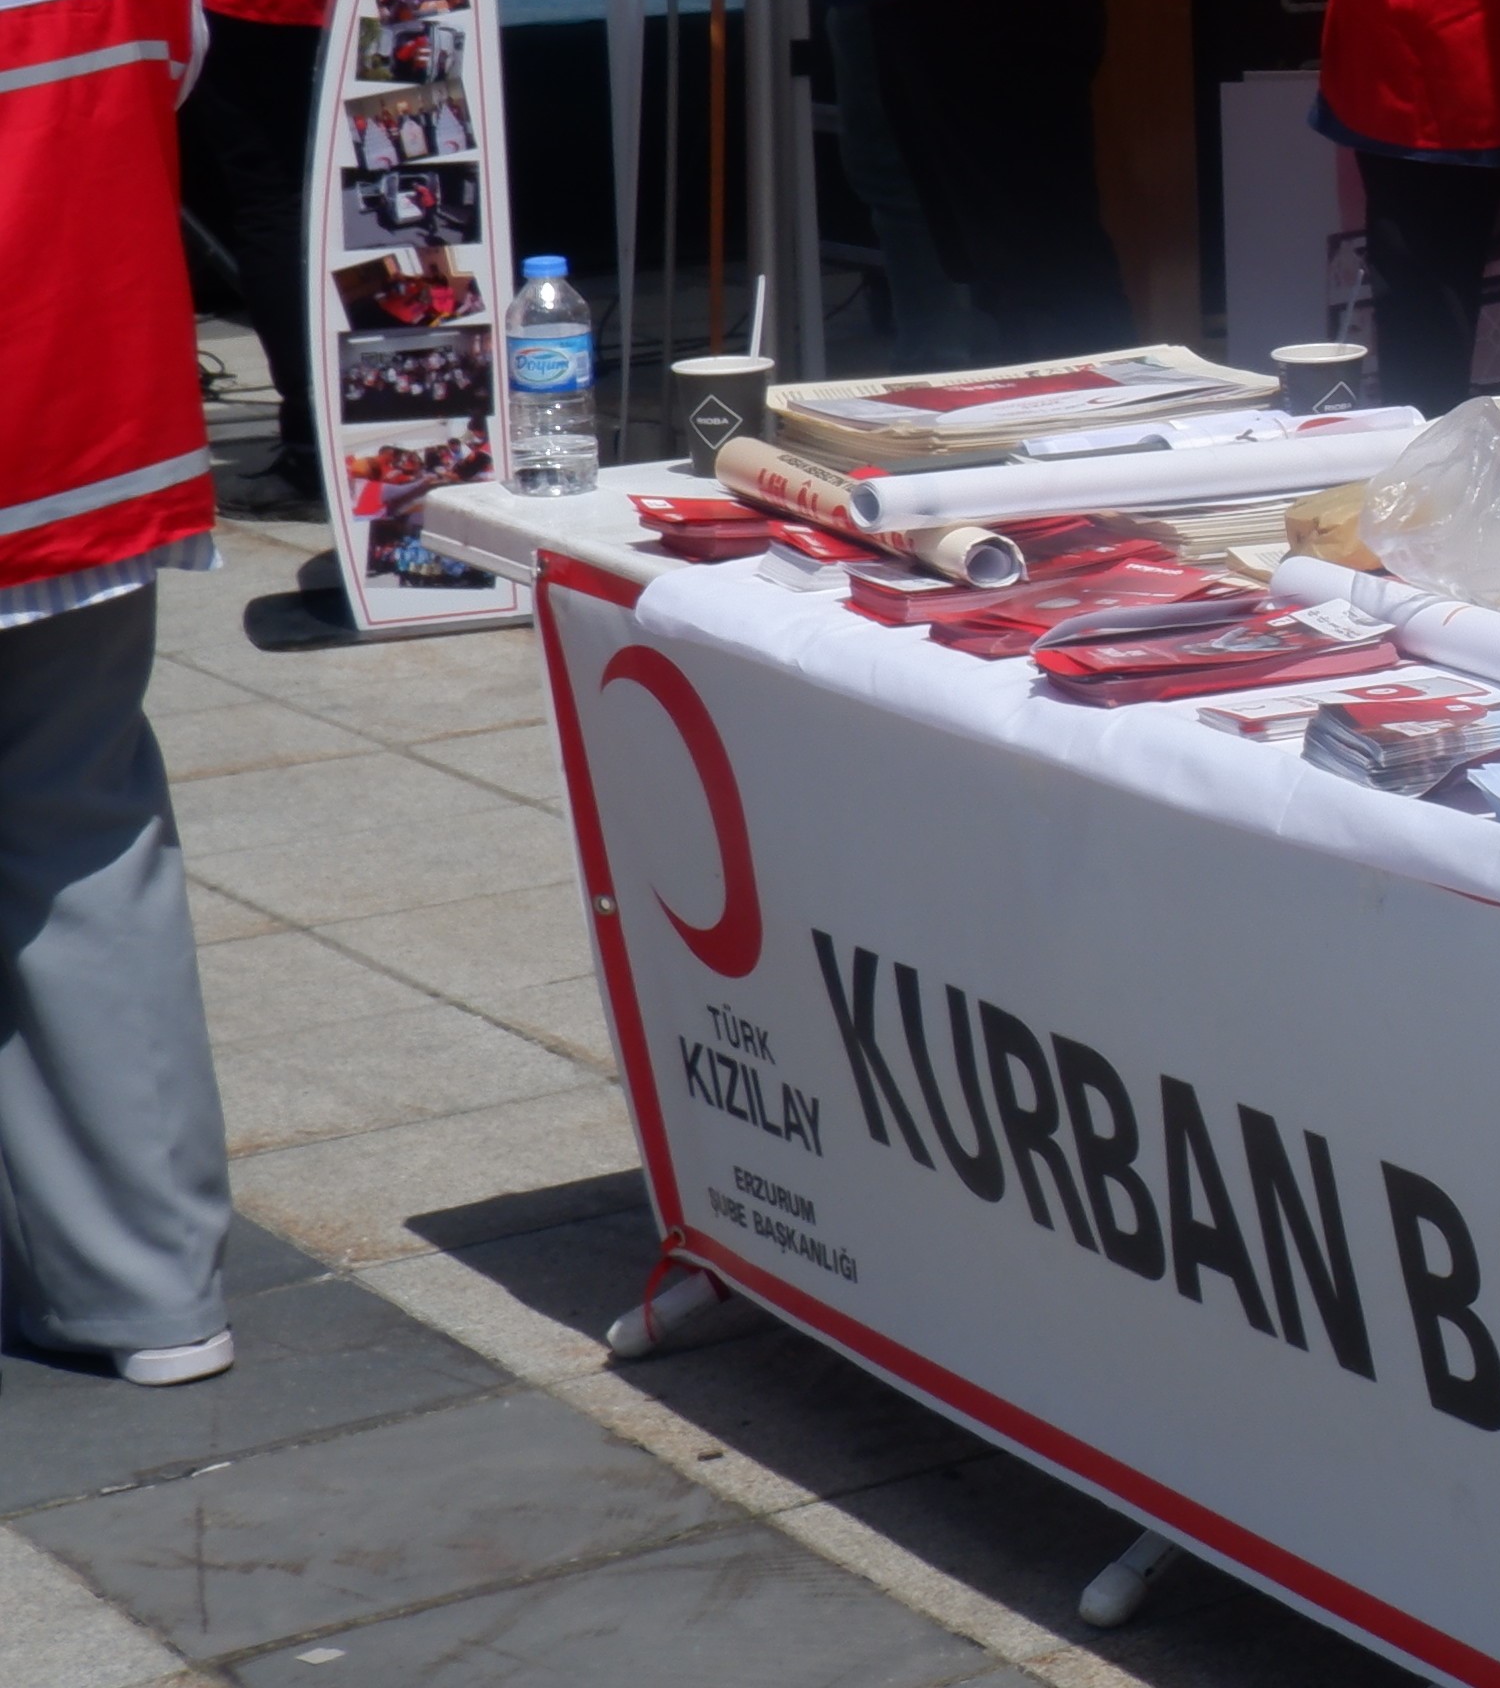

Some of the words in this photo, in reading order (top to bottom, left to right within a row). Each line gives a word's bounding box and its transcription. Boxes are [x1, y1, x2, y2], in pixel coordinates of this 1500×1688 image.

[707, 1004, 776, 1065] TÜRK
[679, 1034, 823, 1157] KIZILAY
[811, 927, 1377, 1383] KURBAN
[734, 1167, 816, 1225] ERZURUM
[752, 1212, 858, 1285] BAŞKANLIĞI
